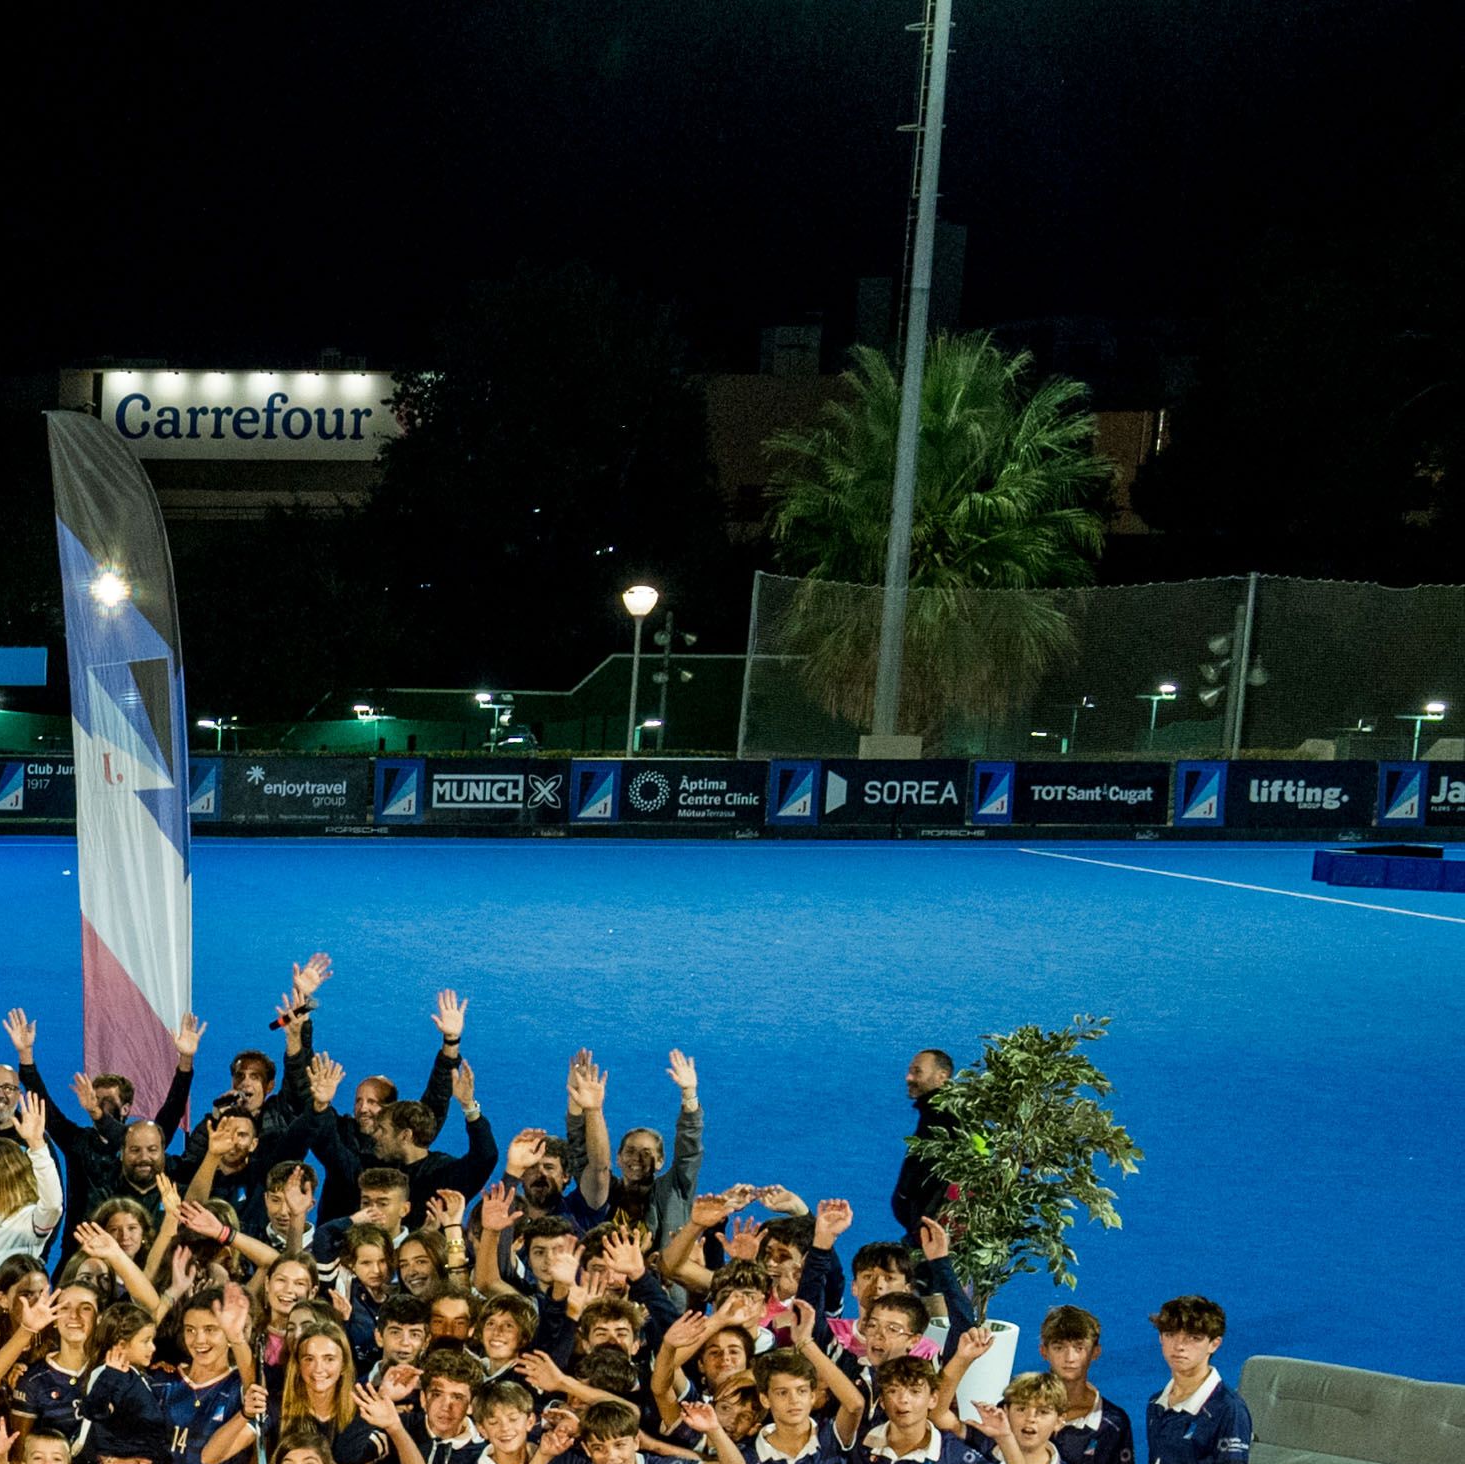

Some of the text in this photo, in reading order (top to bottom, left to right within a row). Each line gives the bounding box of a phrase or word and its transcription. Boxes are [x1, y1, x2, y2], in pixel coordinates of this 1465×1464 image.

[115, 392, 373, 441] Carrefour
[27, 764, 53, 775] Club
[27, 780, 50, 790] 1917
[263, 780, 347, 796] enjoytravel
[433, 781, 523, 802] MUNICH
[679, 775, 727, 790] Àptima
[312, 794, 346, 808] group
[678, 791, 760, 806] Centre Clínic
[863, 780, 958, 805] SOREA
[1030, 785, 1154, 805] TOT Sant Cugat
[1249, 779, 1350, 810] lifting.
[171, 1425, 189, 1454] 14
